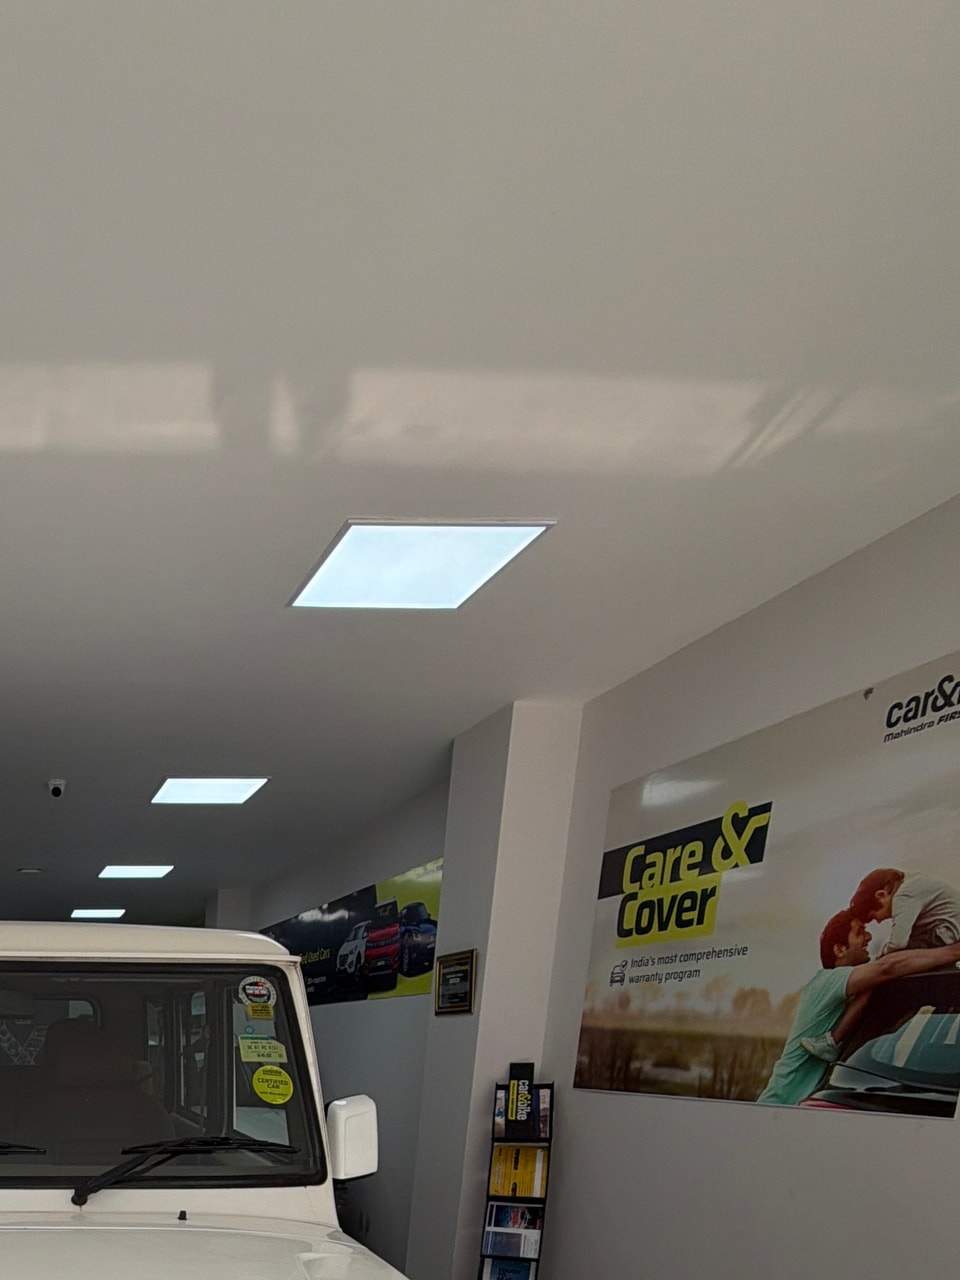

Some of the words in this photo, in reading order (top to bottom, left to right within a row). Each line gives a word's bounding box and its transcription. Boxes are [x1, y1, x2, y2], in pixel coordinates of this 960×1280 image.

[886, 674, 960, 728] car&
[623, 840, 704, 893] Care
[711, 801, 771, 872] &
[617, 884, 717, 938] Cover
[628, 972, 664, 985] warranty
[664, 968, 701, 983] program
[630, 955, 656, 969] India's
[657, 953, 678, 965] most
[679, 944, 749, 964] comprehensive
